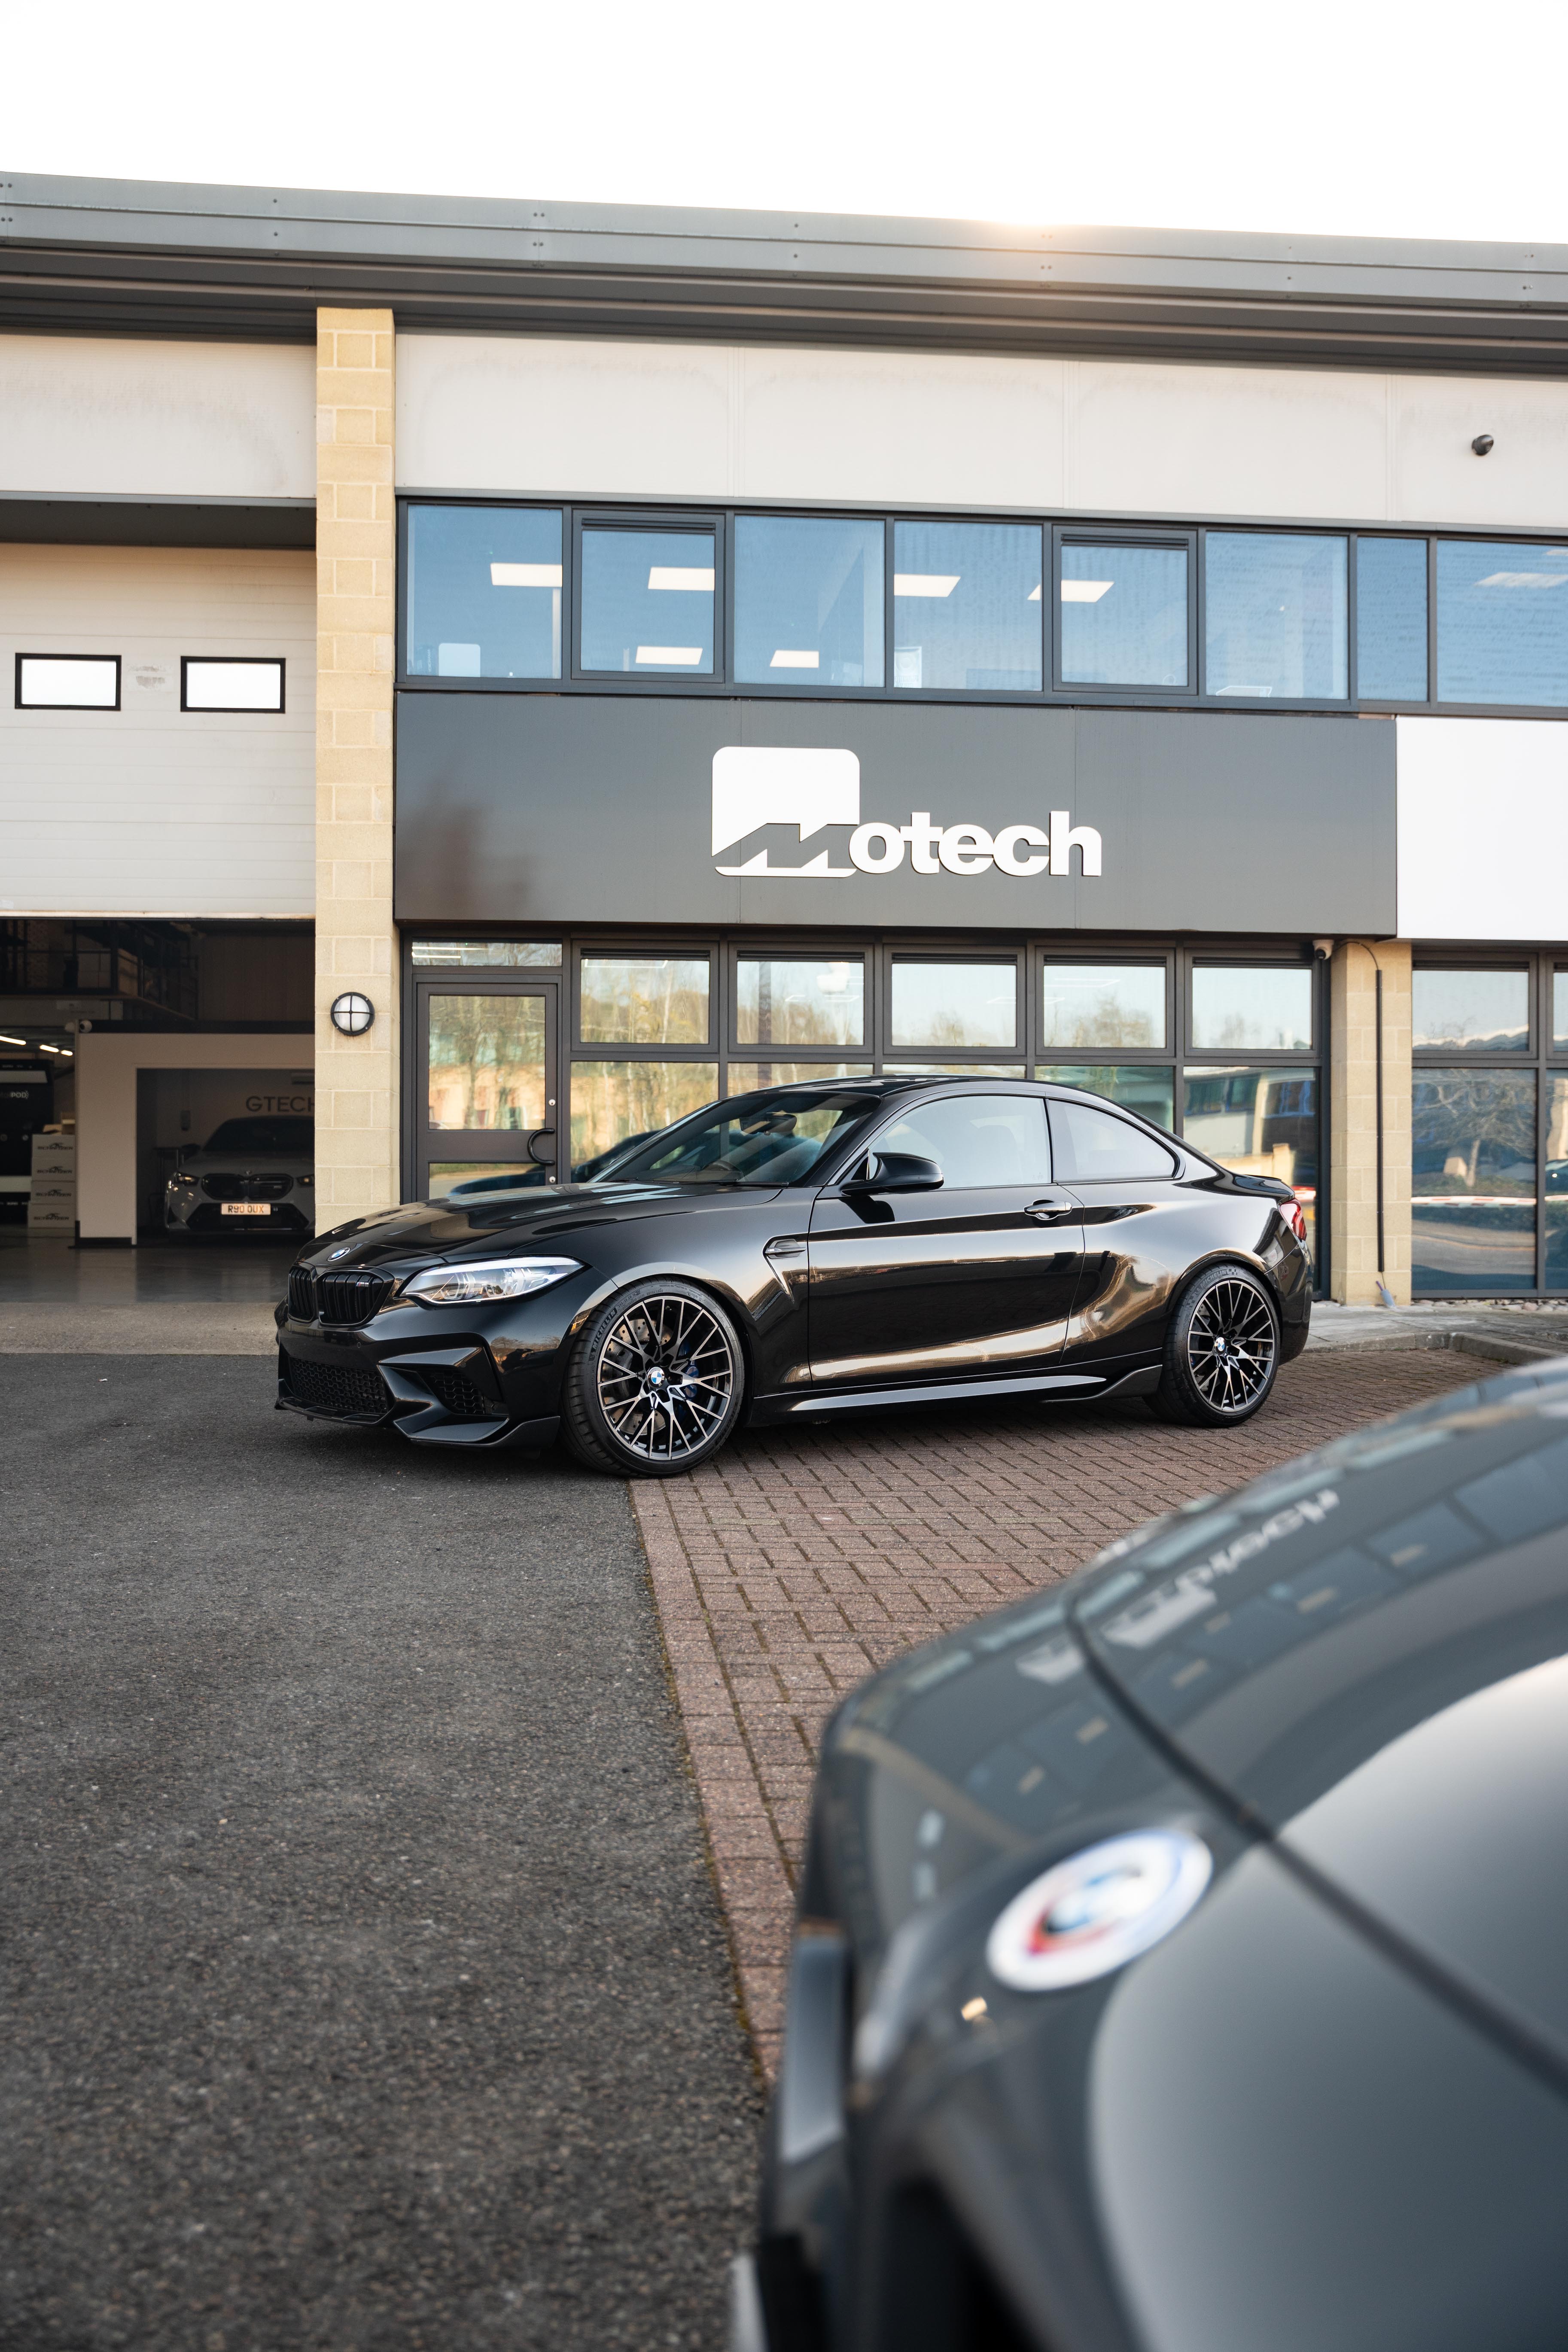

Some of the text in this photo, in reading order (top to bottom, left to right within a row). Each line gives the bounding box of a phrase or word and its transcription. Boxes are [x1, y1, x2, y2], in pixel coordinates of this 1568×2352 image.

[228, 1205, 245, 1213] R90
[1200, 1269, 1227, 1287] MICHELIN
[593, 1308, 616, 1350] MICHELIN
